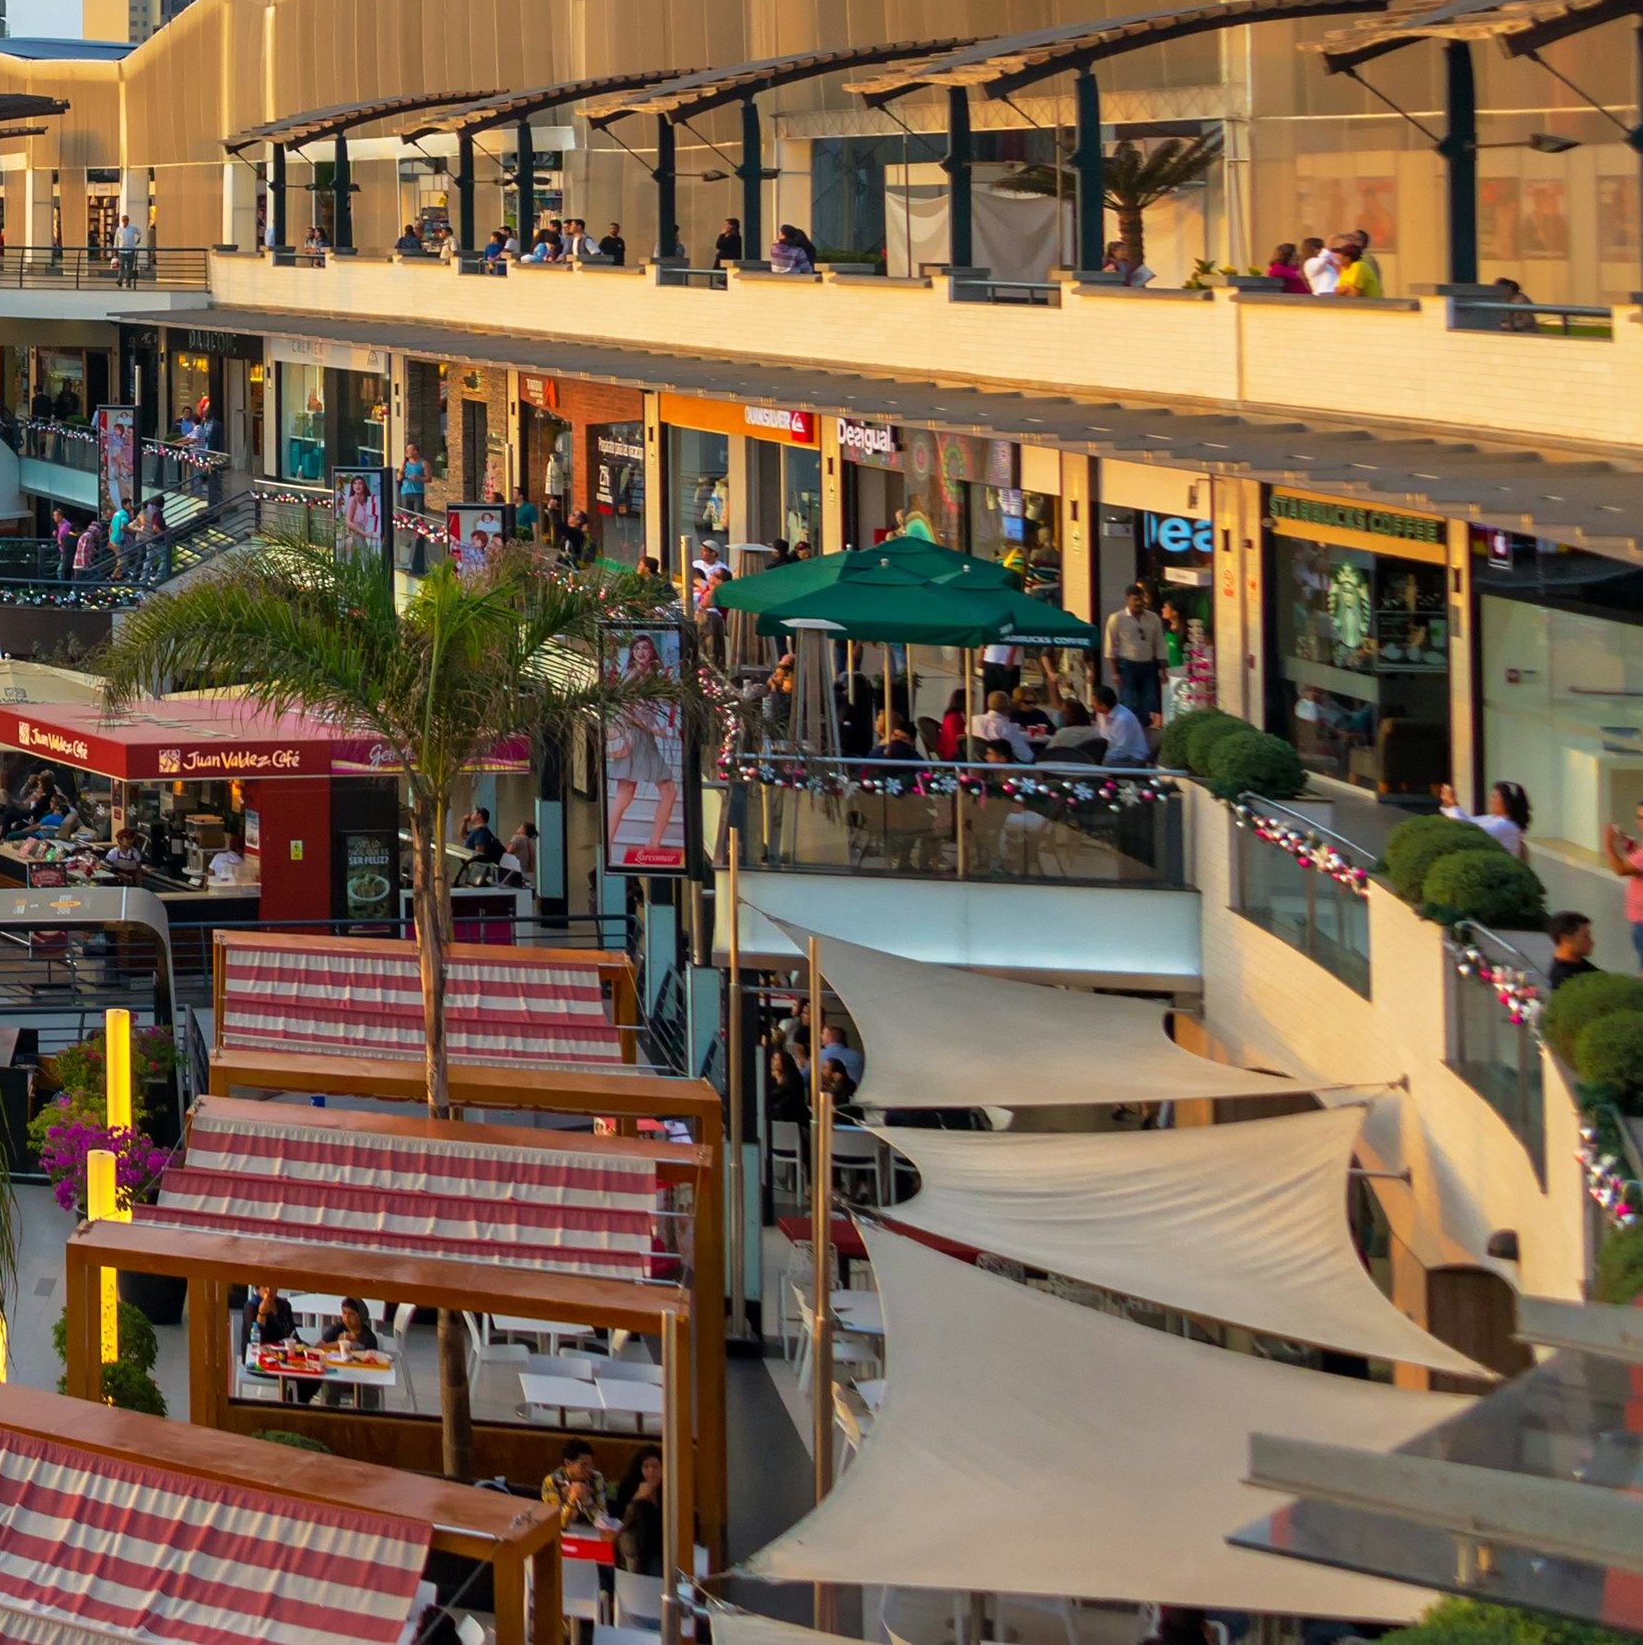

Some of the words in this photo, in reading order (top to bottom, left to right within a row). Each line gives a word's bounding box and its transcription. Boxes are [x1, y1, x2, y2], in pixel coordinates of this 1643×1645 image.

[1269, 493, 1366, 532] STARBUCKS
[1368, 510, 1438, 543] COFFEE
[30, 728, 49, 747] Juan
[182, 751, 221, 769] Juan
[220, 751, 270, 767] Valdez
[272, 750, 300, 768] Café
[348, 856, 363, 865] SER
[635, 850, 676, 865] Larcomar
